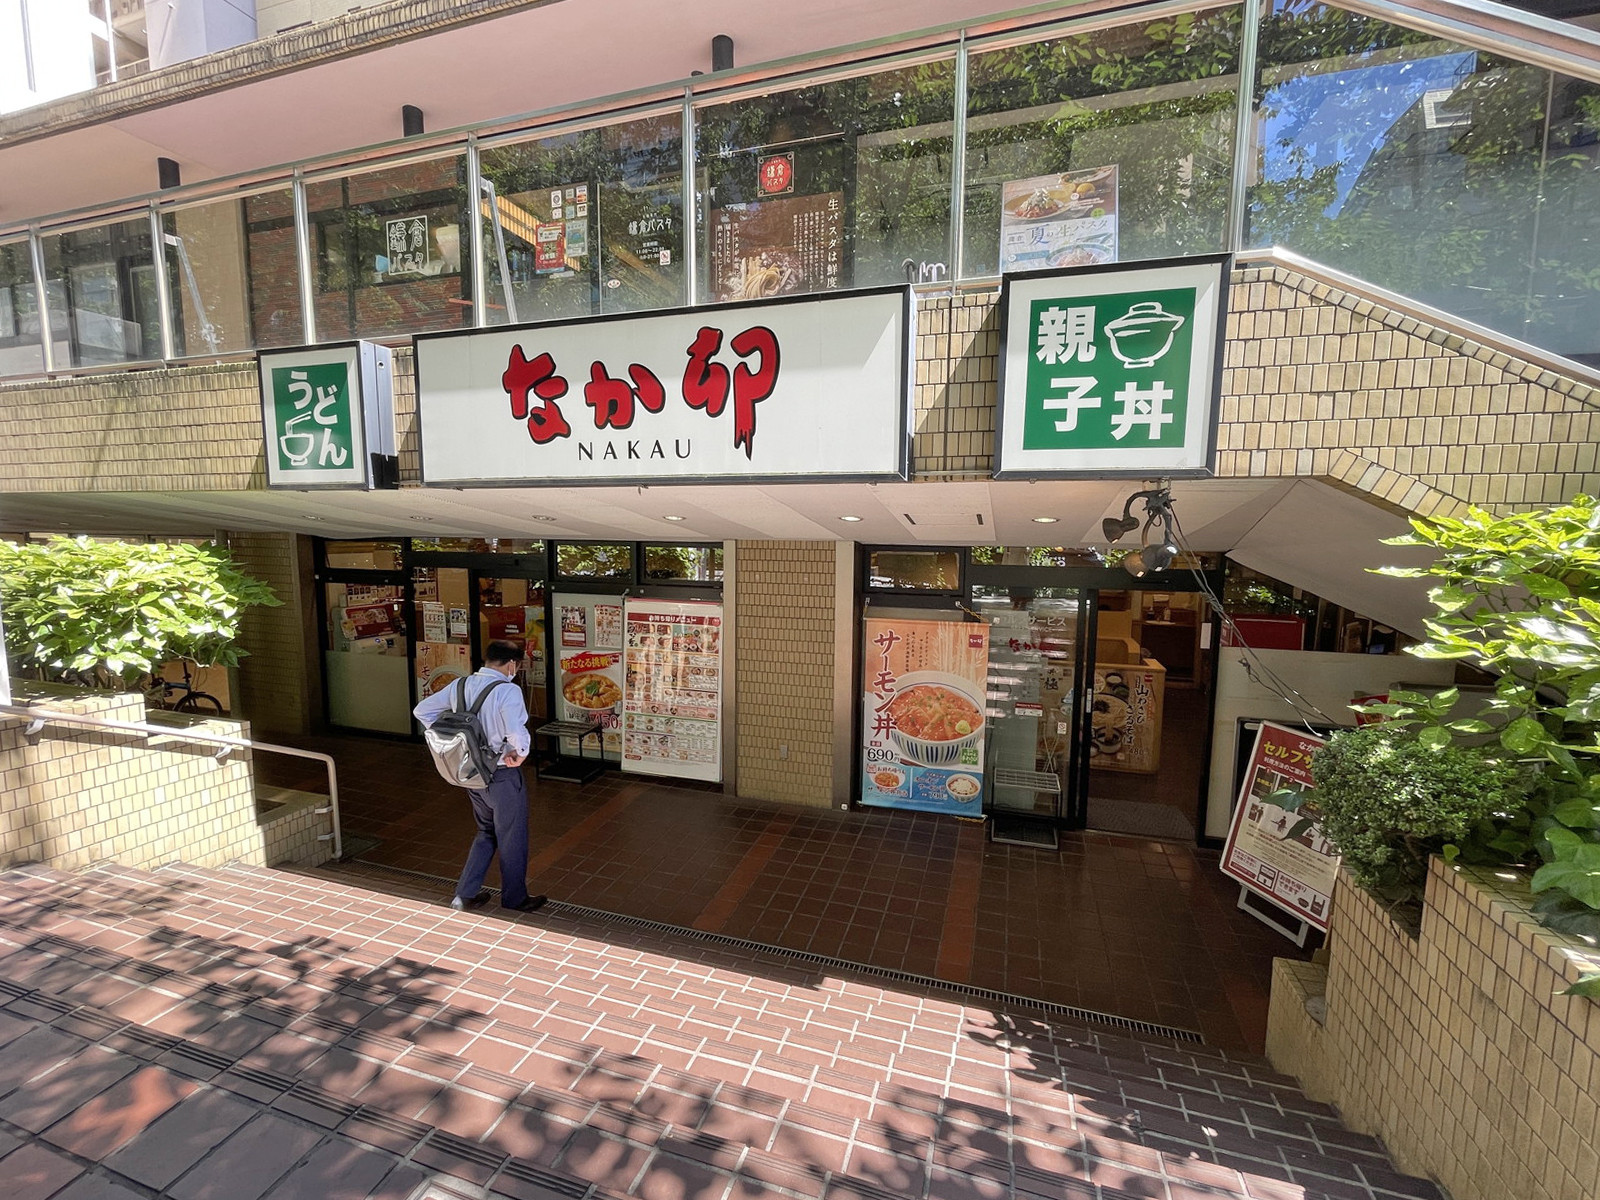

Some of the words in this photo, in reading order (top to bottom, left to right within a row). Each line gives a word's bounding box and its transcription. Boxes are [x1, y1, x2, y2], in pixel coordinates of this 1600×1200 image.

[628, 217, 672, 236] 鎌倉パスタ
[827, 198, 839, 289] 生パスタは鮮度
[288, 370, 348, 466] うどん
[502, 326, 780, 461] なか卯
[578, 439, 692, 461] NAKAU
[870, 630, 902, 741] サーモン丼
